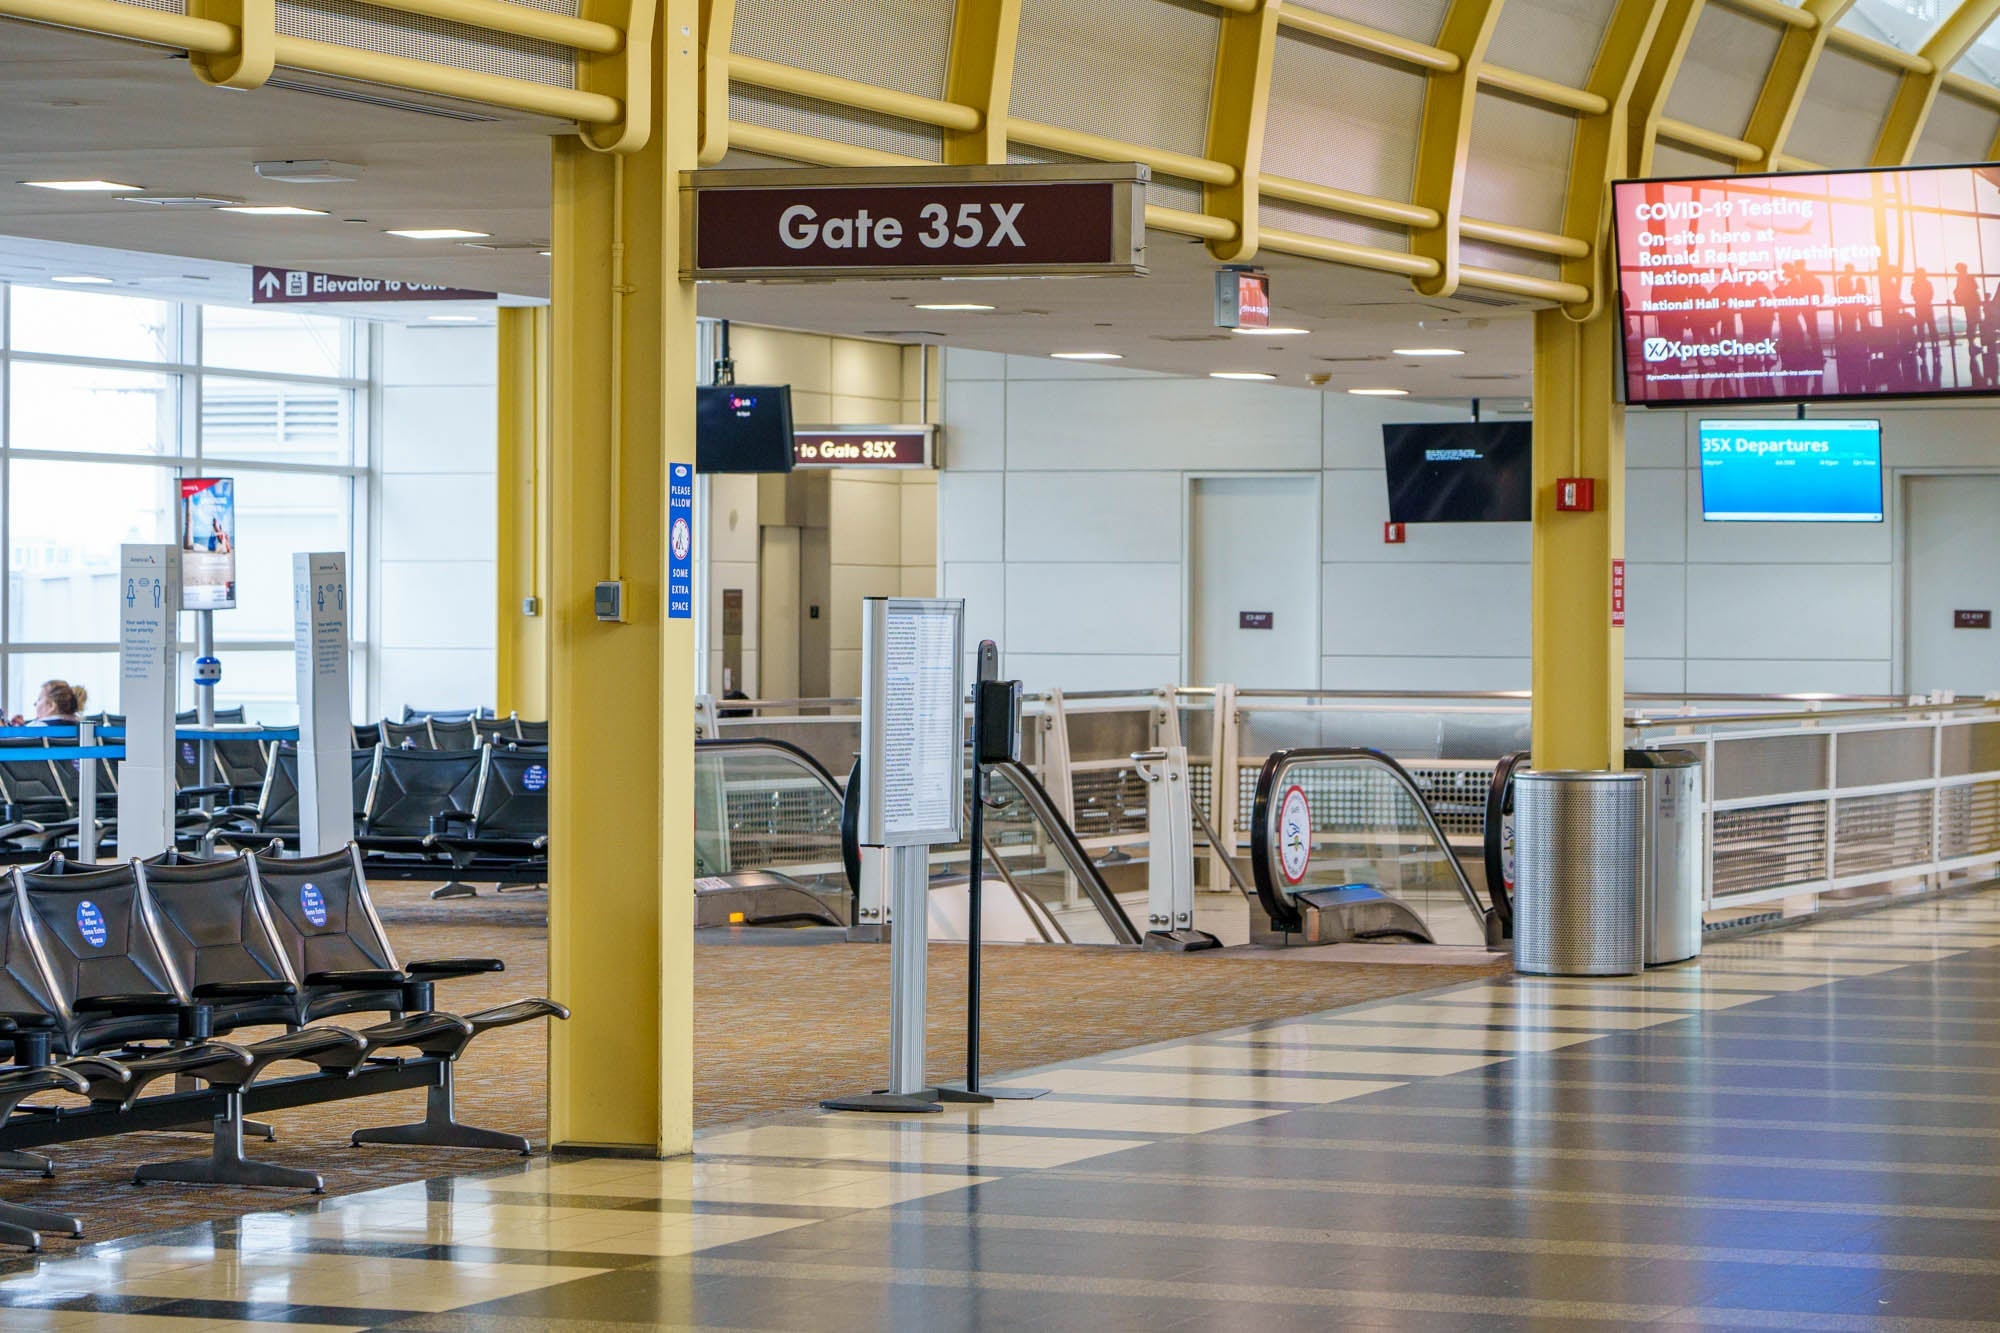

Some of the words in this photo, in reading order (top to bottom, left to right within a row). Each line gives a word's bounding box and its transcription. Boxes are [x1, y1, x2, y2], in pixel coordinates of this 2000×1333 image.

[1635, 202, 1733, 220] COVID-19
[1738, 198, 1814, 218] Testing
[778, 204, 903, 249] Gate
[918, 203, 1026, 248] 35X
[1638, 229, 1705, 247] On-site
[1710, 229, 1750, 243] here
[1756, 228, 1775, 242] at
[1639, 250, 1700, 267] Ronald
[1705, 249, 1769, 267] Reagan
[1774, 244, 1882, 263] Washington
[313, 275, 379, 293] Elevator
[1640, 269, 1715, 286] National
[1720, 268, 1785, 286] Airport
[1642, 299, 1693, 311] National
[1696, 298, 1720, 310] Hall
[1728, 298, 1756, 309] Near
[1759, 296, 1809, 307] Terminal
[1823, 294, 1873, 306] Security
[1667, 338, 1777, 361] XpresCheck
[800, 443, 818, 458] to
[820, 441, 860, 458] Gate
[862, 441, 897, 458] 35X
[1703, 438, 1732, 452] 35X
[1736, 438, 1830, 456] Departures
[671, 485, 691, 495] PLEASE
[671, 498, 691, 507] ALLOW
[672, 568, 689, 578] SOME
[671, 585, 689, 594] EXTRA
[671, 602, 689, 611] SPACE
[81, 909, 96, 917] Please
